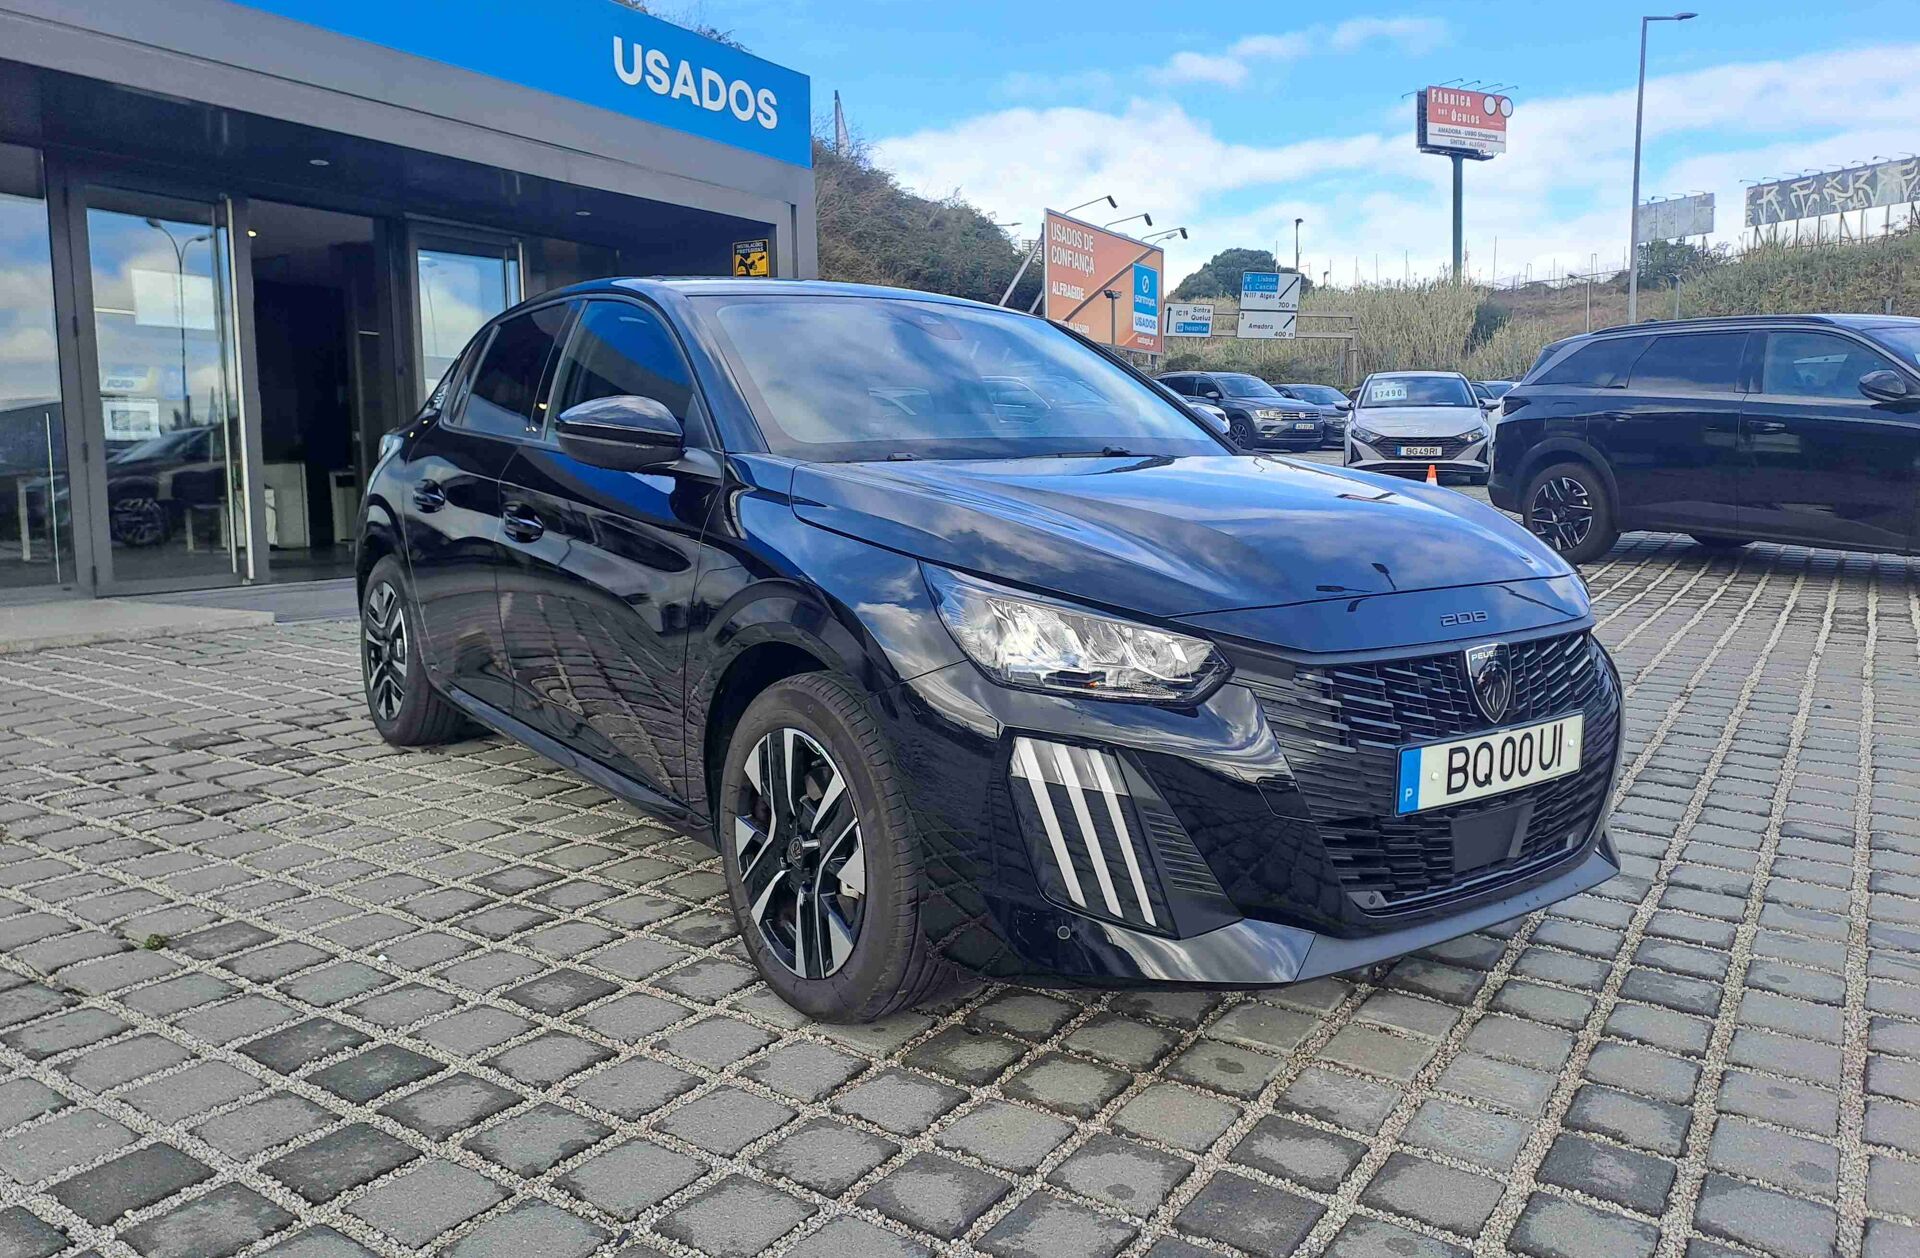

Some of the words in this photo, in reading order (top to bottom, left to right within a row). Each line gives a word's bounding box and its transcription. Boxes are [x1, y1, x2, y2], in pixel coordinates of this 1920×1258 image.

[613, 35, 778, 130] USADOS
[1051, 222, 1082, 248] USADOS
[1084, 233, 1094, 252] DE
[1051, 246, 1095, 277] CONFIANÇA
[1052, 281, 1085, 301] ALFRAGIDE
[1134, 316, 1157, 330] USADOS
[1184, 324, 1209, 332] hospital
[1440, 610, 1489, 627] 208
[1404, 787, 1413, 802] P
